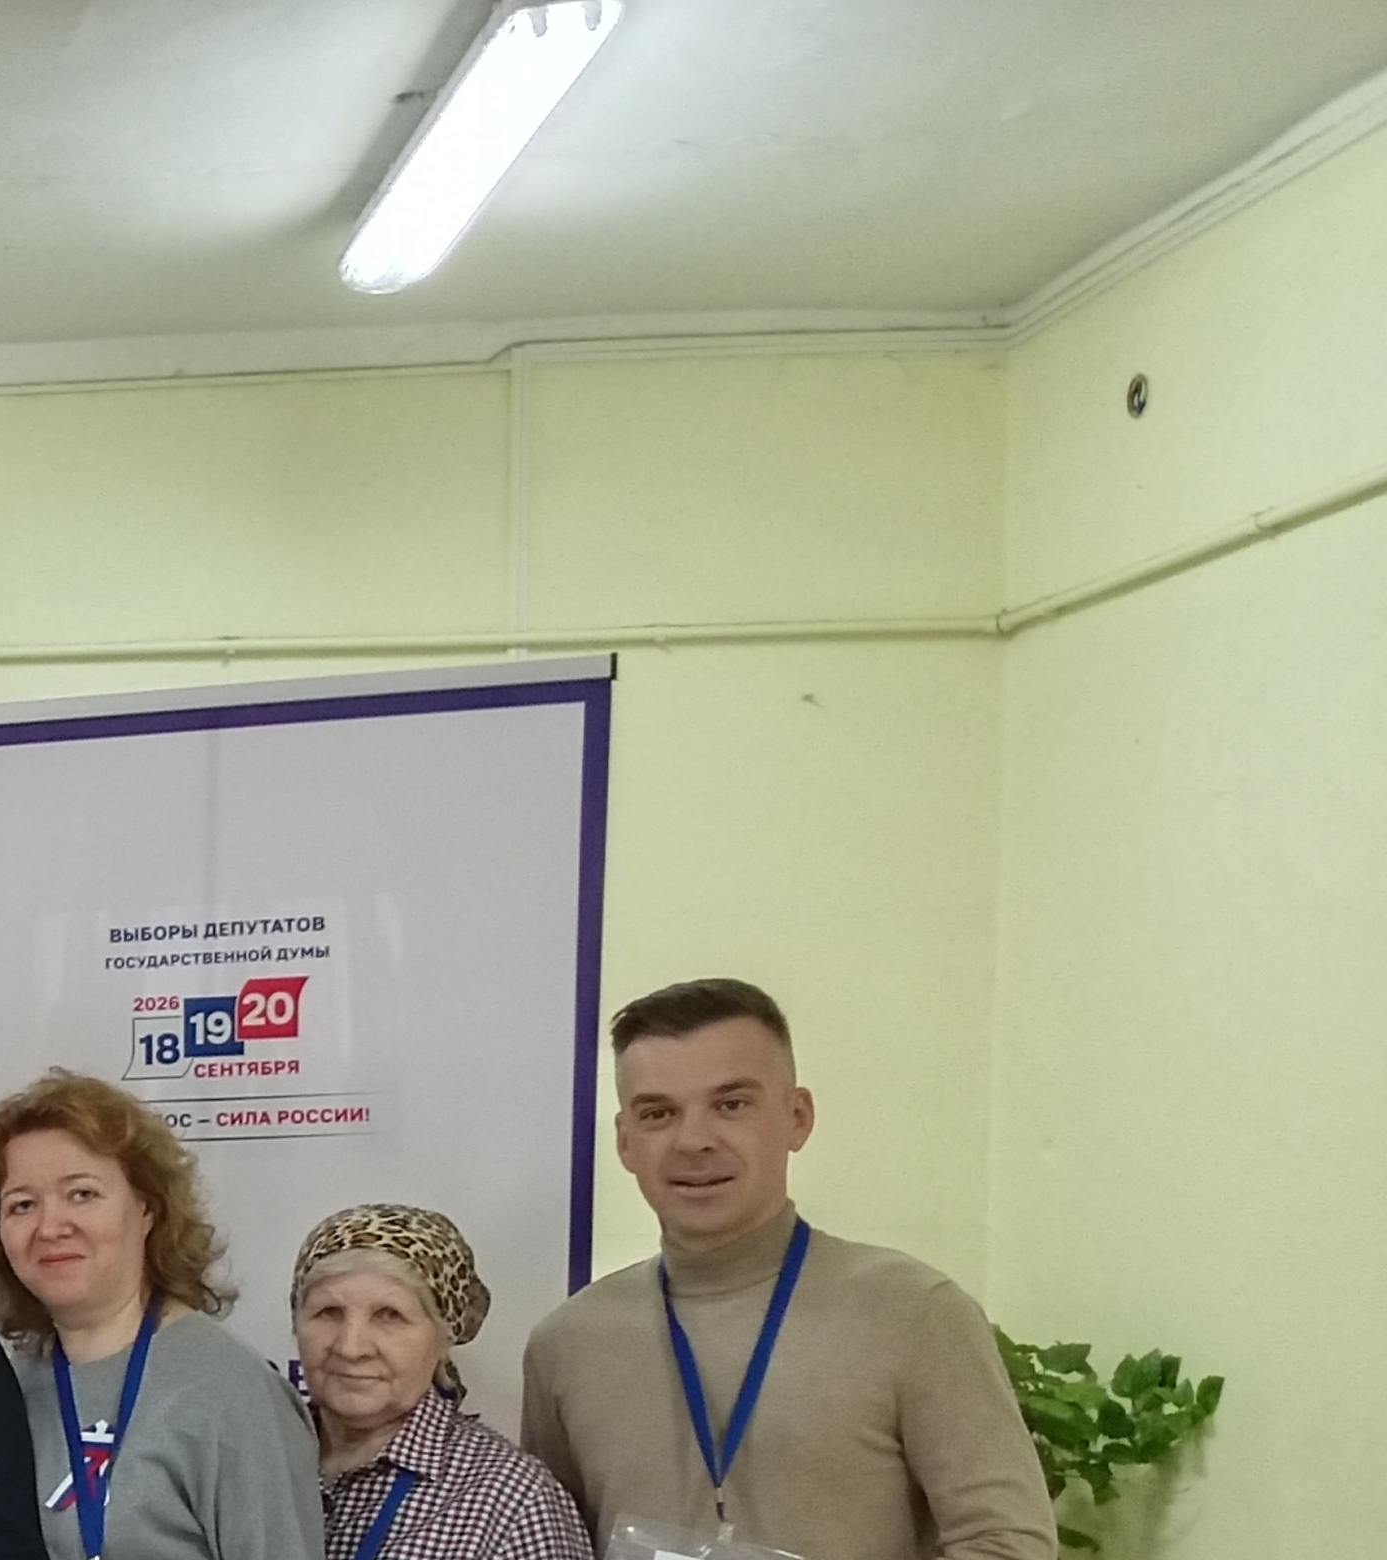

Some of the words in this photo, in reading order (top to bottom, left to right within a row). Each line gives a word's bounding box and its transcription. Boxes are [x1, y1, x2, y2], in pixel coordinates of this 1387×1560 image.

[109, 924, 198, 943] ВЫБОРЫ
[203, 916, 326, 941] ДЕПУТАТОВ
[105, 946, 272, 969] ГОСУДАРСТВЕННОЙ
[276, 945, 330, 963] ДУМЫ
[132, 996, 180, 1012] 2026
[139, 1032, 181, 1066] 18
[189, 1010, 232, 1046] 19
[241, 991, 294, 1026] 20
[193, 1060, 300, 1078] СЕНТЯБРЯ
[216, 1110, 271, 1126] СИЛА
[277, 1107, 370, 1125] РОССИИ!
